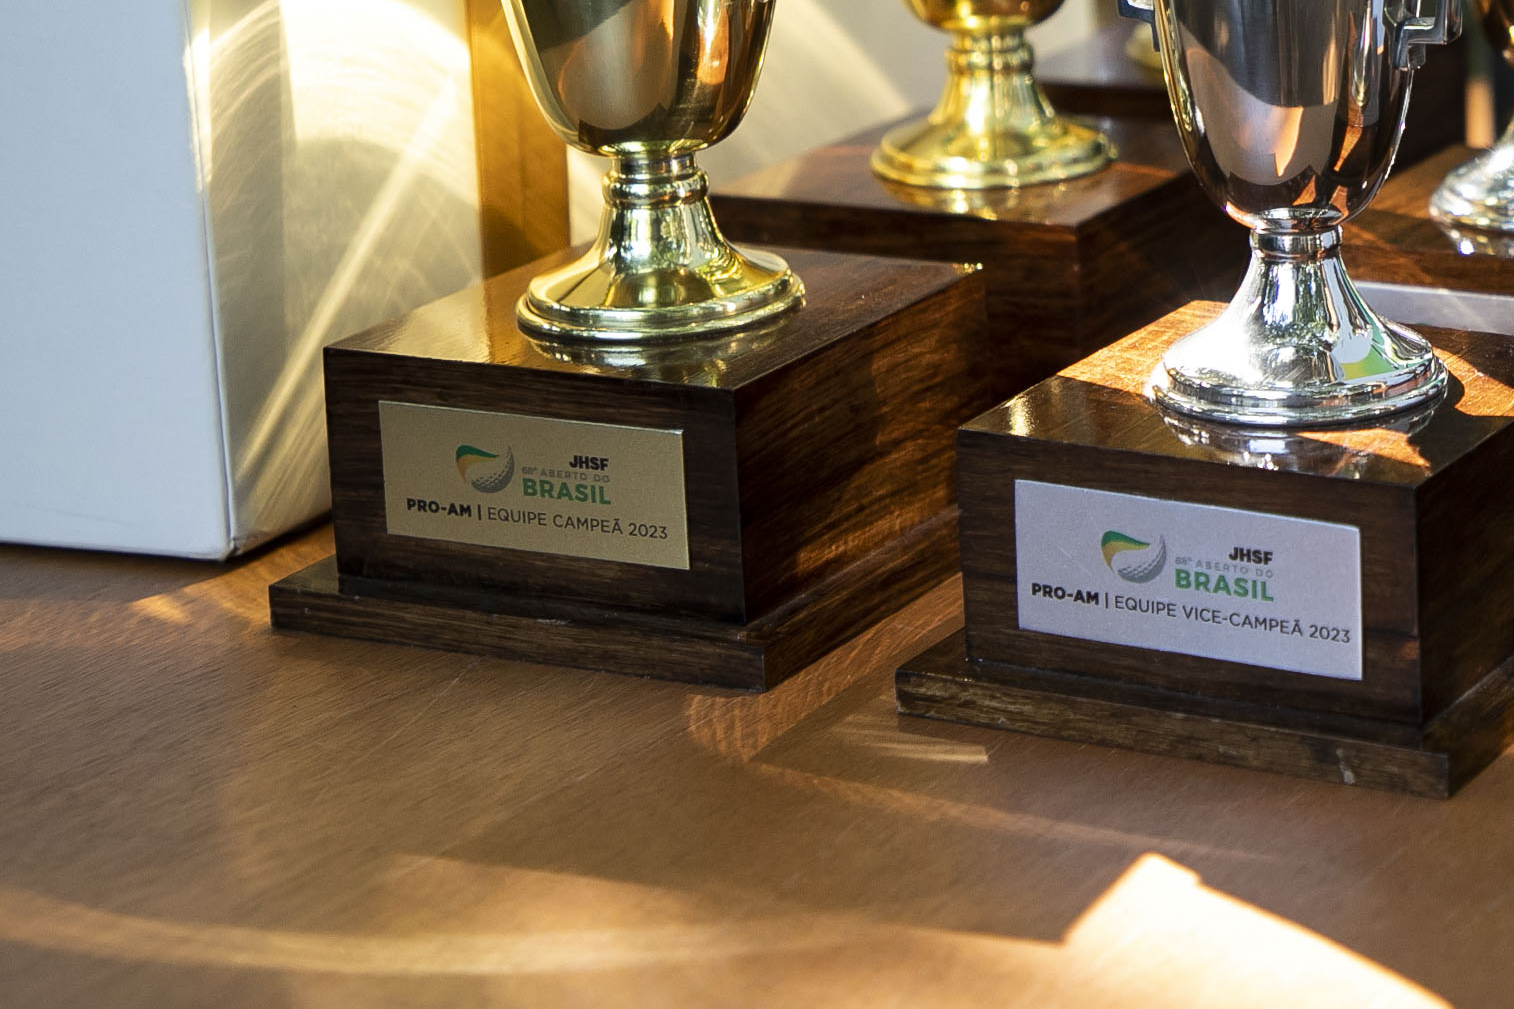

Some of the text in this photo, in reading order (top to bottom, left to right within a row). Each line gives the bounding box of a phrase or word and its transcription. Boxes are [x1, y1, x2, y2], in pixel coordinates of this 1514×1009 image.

[569, 454, 609, 471] JHSF
[541, 469, 588, 481] ABERTO
[593, 474, 611, 483] DO
[522, 478, 612, 505] BRASIL
[407, 498, 472, 517] PRO-AM
[488, 507, 547, 527] EQUIPE
[553, 515, 623, 535] CAMPEÃ
[628, 523, 668, 540] 2023
[1228, 547, 1274, 566] JHSF
[1195, 560, 1248, 576] ABERTO
[1256, 568, 1274, 579] DO
[1175, 568, 1275, 603] BRASIL
[1031, 583, 1100, 606] PRO-AM
[1115, 596, 1177, 618] EQUIPE
[1182, 604, 1304, 637] VICE-CAMPEÃ
[1309, 624, 1351, 644] 2023
